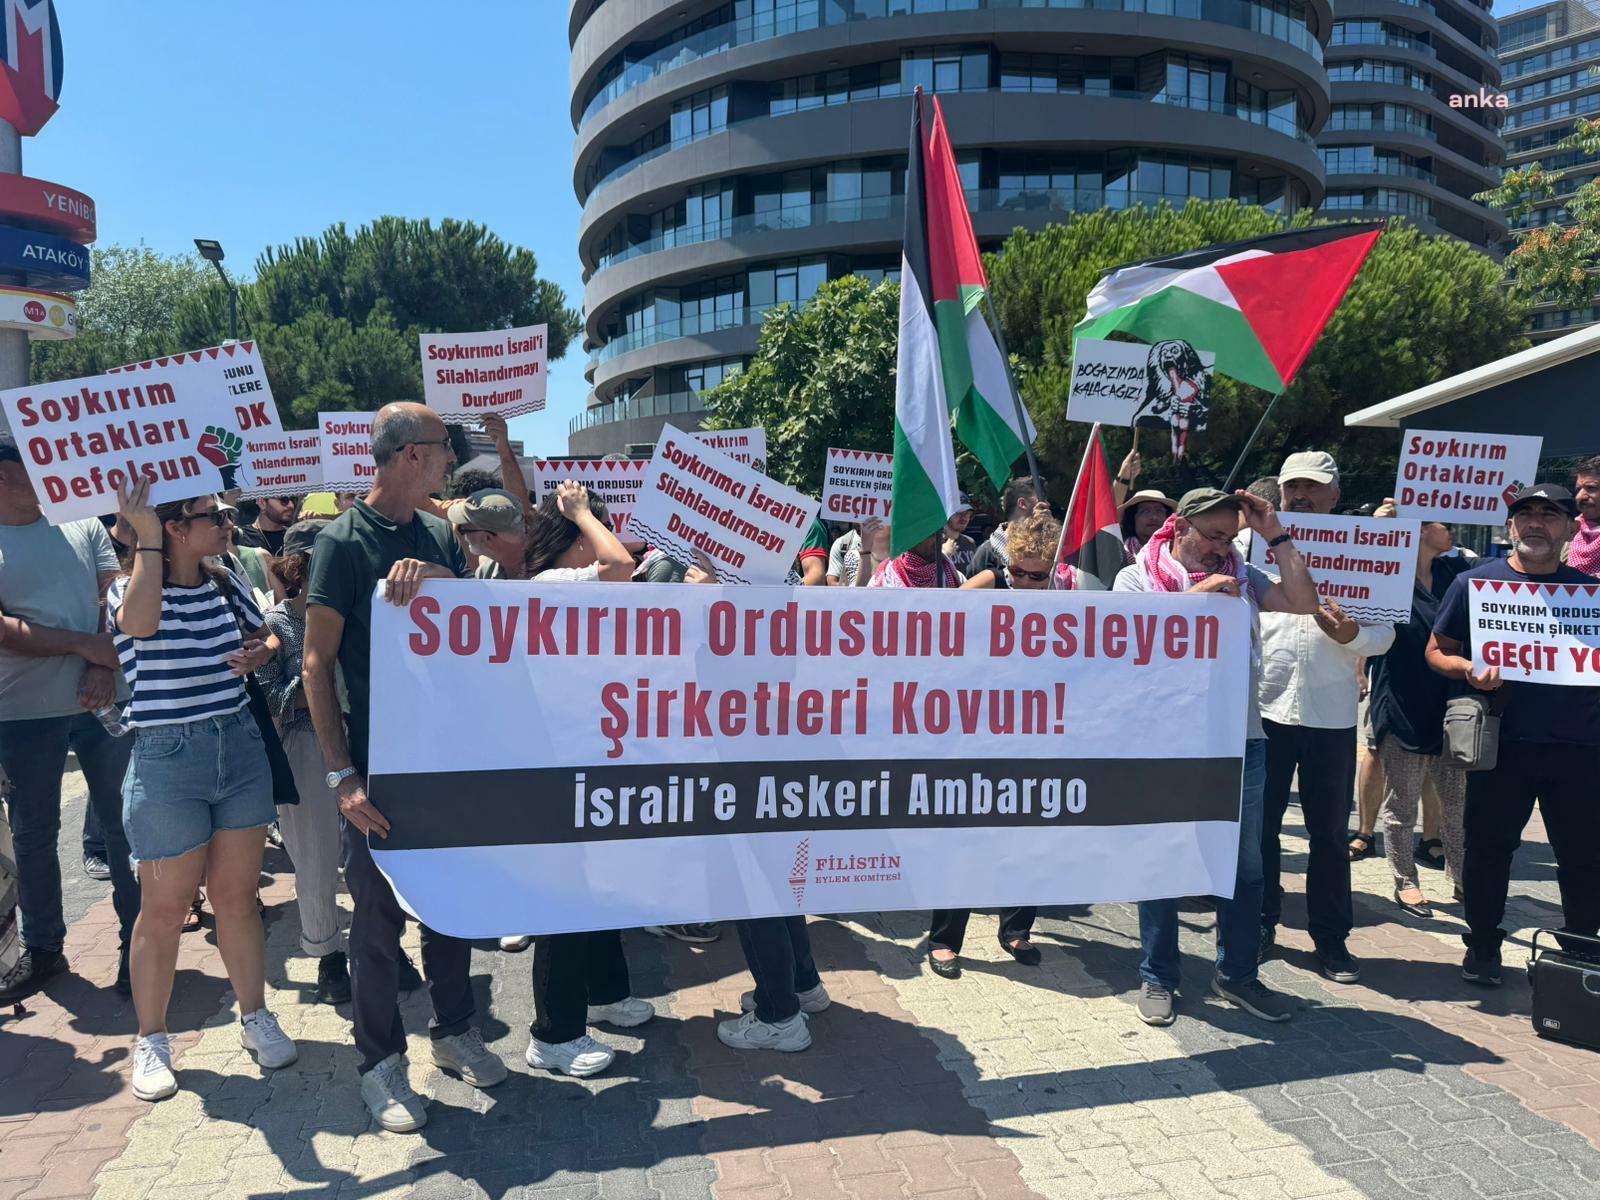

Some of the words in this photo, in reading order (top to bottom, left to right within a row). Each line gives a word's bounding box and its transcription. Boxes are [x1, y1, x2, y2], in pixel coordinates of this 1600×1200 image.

[22, 244, 84, 270] ATAKÖY
[428, 344, 503, 361] Soykırımcı
[507, 335, 543, 355] İsrail’i
[436, 361, 539, 384] Silahlandırmayı
[17, 382, 176, 427] Soykırım
[462, 388, 522, 407] Durdurun
[325, 421, 373, 435] Soykırı
[28, 419, 190, 465] Ortakları
[246, 441, 286, 452] kırımcı
[1408, 436, 1507, 460] Soykırım
[252, 456, 320, 470] hlandırmayı
[833, 465, 875, 477] SOYKIRIM
[1404, 461, 1504, 486] Ortakları
[42, 455, 201, 503] Defolsun
[597, 480, 643, 489] ORDUSU
[661, 440, 747, 499] Soykırımcı
[747, 483, 807, 529] İsrail’i
[829, 477, 871, 489] BESLEYEN
[828, 493, 877, 518] GEÇİT
[1400, 487, 1499, 511] Defolsun
[656, 472, 785, 553] Silahlandırmayı
[667, 513, 746, 568] Durdurun
[1283, 524, 1348, 543] kırımcı
[1353, 525, 1412, 548] İsrail’i
[1315, 580, 1370, 599] durun
[1481, 602, 1547, 617] SOYKIRIM
[408, 596, 681, 663] Soykırım
[708, 600, 966, 657] Ordusunu
[989, 604, 1220, 666] Besleyen
[1478, 618, 1544, 634] BESLEYEN
[1482, 640, 1558, 675] GEÇİT
[600, 678, 868, 758] Şirketleri
[892, 681, 1066, 735] Kovun!
[574, 773, 736, 828] İsrail’e
[755, 771, 890, 819] Askeri
[908, 772, 1087, 819] Ambargo
[815, 853, 901, 871] FİLİSTİN
[815, 875, 850, 883] EYLEM
[854, 872, 901, 882] KOMİTESİ
